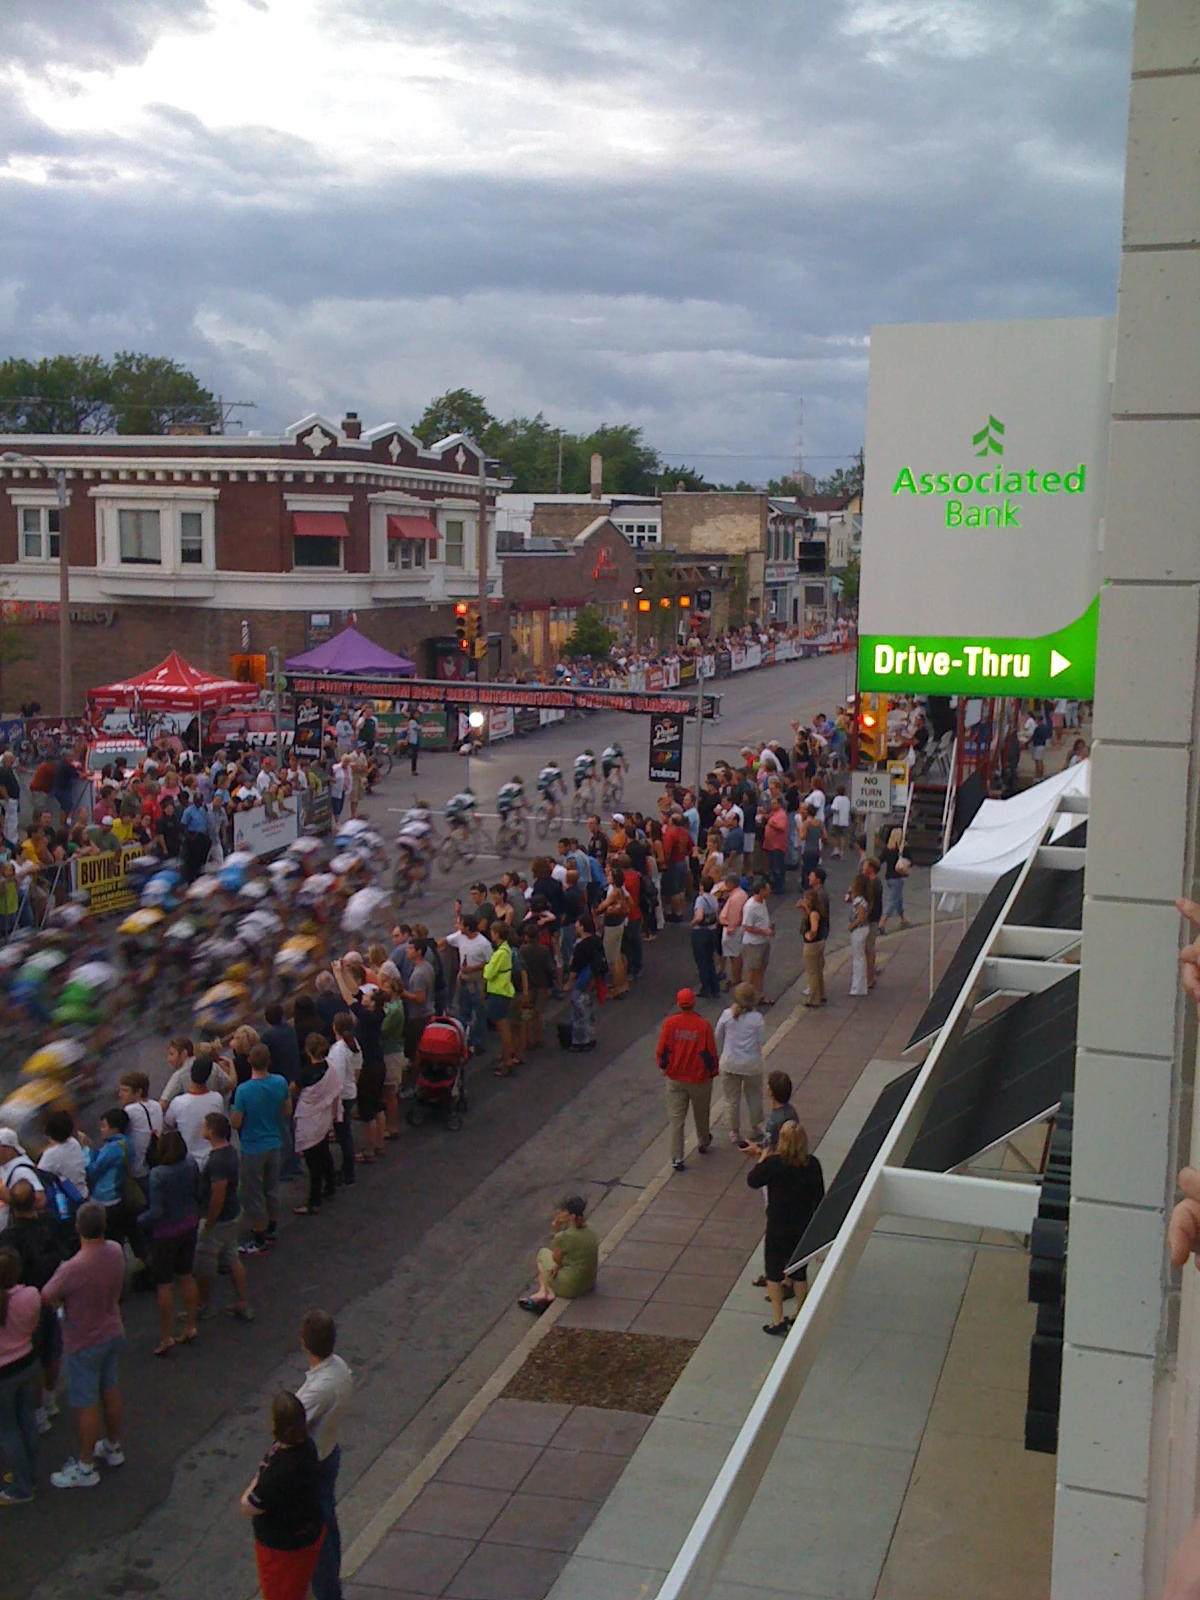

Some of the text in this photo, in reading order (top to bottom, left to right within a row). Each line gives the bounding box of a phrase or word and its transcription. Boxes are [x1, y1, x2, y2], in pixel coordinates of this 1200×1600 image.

[892, 463, 1086, 495] Associated
[945, 499, 1021, 528] Bank
[873, 644, 1031, 678] Drive-Thru
[863, 776, 879, 786] NO
[860, 787, 882, 797] TURN
[855, 798, 886, 809] ON RED
